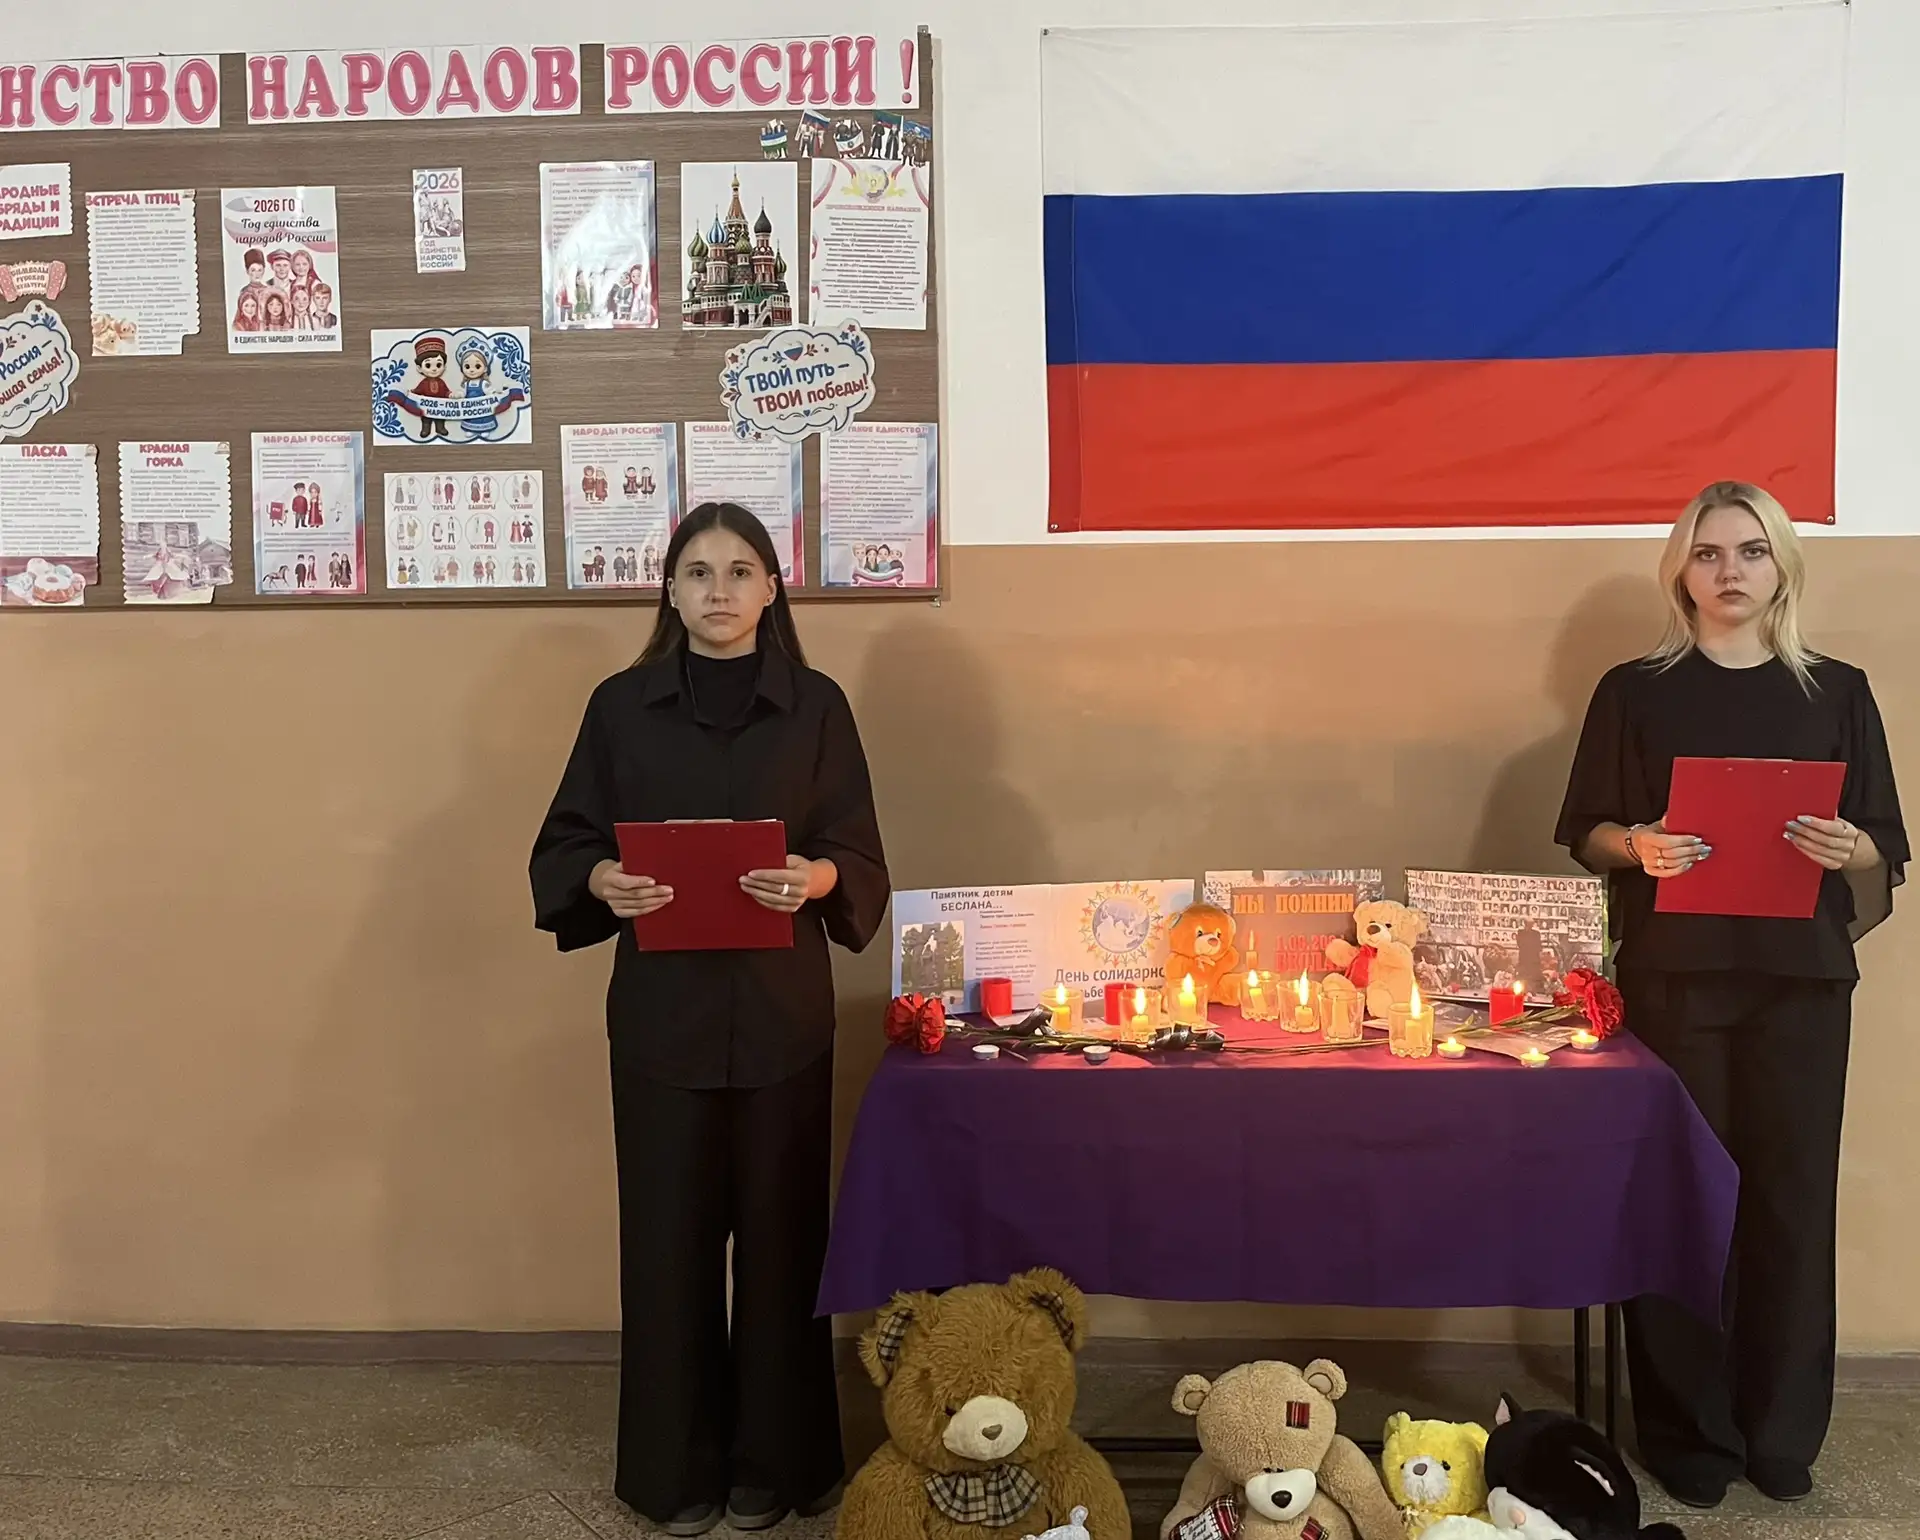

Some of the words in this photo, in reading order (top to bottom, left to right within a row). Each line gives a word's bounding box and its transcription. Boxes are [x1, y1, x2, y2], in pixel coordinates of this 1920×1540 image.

[0, 58, 218, 128] НСТВО
[248, 46, 579, 120] НАРОДОВ
[607, 36, 877, 108] РОССИИ
[900, 38, 915, 104] !
[416, 173, 460, 189] 2026
[0, 184, 60, 199] РОДНЫЕ
[144, 193, 181, 206] ПТИЦ
[50, 200, 60, 212] И
[253, 199, 280, 213] 2026
[241, 218, 262, 233] Год
[264, 216, 320, 232] единства
[235, 231, 283, 247] народов
[284, 232, 327, 243] России
[420, 246, 462, 255] ЕДИНСТВА
[420, 253, 458, 262] НАРОДОВ
[420, 261, 454, 269] РОССИИ
[0, 345, 42, 380] Россия
[27, 346, 64, 384] семья!
[745, 364, 793, 393] ТВОЙ
[796, 363, 835, 384] путь
[753, 389, 803, 414] ТВОИ
[807, 373, 869, 403] победы!
[420, 398, 438, 408] 2026
[445, 401, 459, 409] ГОД
[461, 396, 499, 409] ЕДИНСТВА
[426, 408, 461, 417] НАРОДОВ
[463, 407, 493, 417] РОССИИ
[572, 427, 618, 437] НАРОДЫ
[621, 426, 663, 435] РОССИИ
[692, 425, 734, 433] СИМВОЛ
[263, 435, 307, 444] НАРОДЫ
[310, 434, 351, 443] РОССИИ
[21, 445, 68, 457] ПАСХА
[139, 443, 190, 454] КРАСНАЯ
[146, 457, 184, 467] ГОРКА
[931, 890, 980, 900] Памятник
[983, 889, 1014, 898] детям
[941, 901, 1003, 912] БЕСЛАНА...
[1233, 894, 1265, 914] МЫ
[1275, 893, 1354, 913] ПОМНИМ
[1054, 968, 1089, 985] День
[1093, 966, 1165, 982] солидарно
[1083, 986, 1104, 998] ьбе
